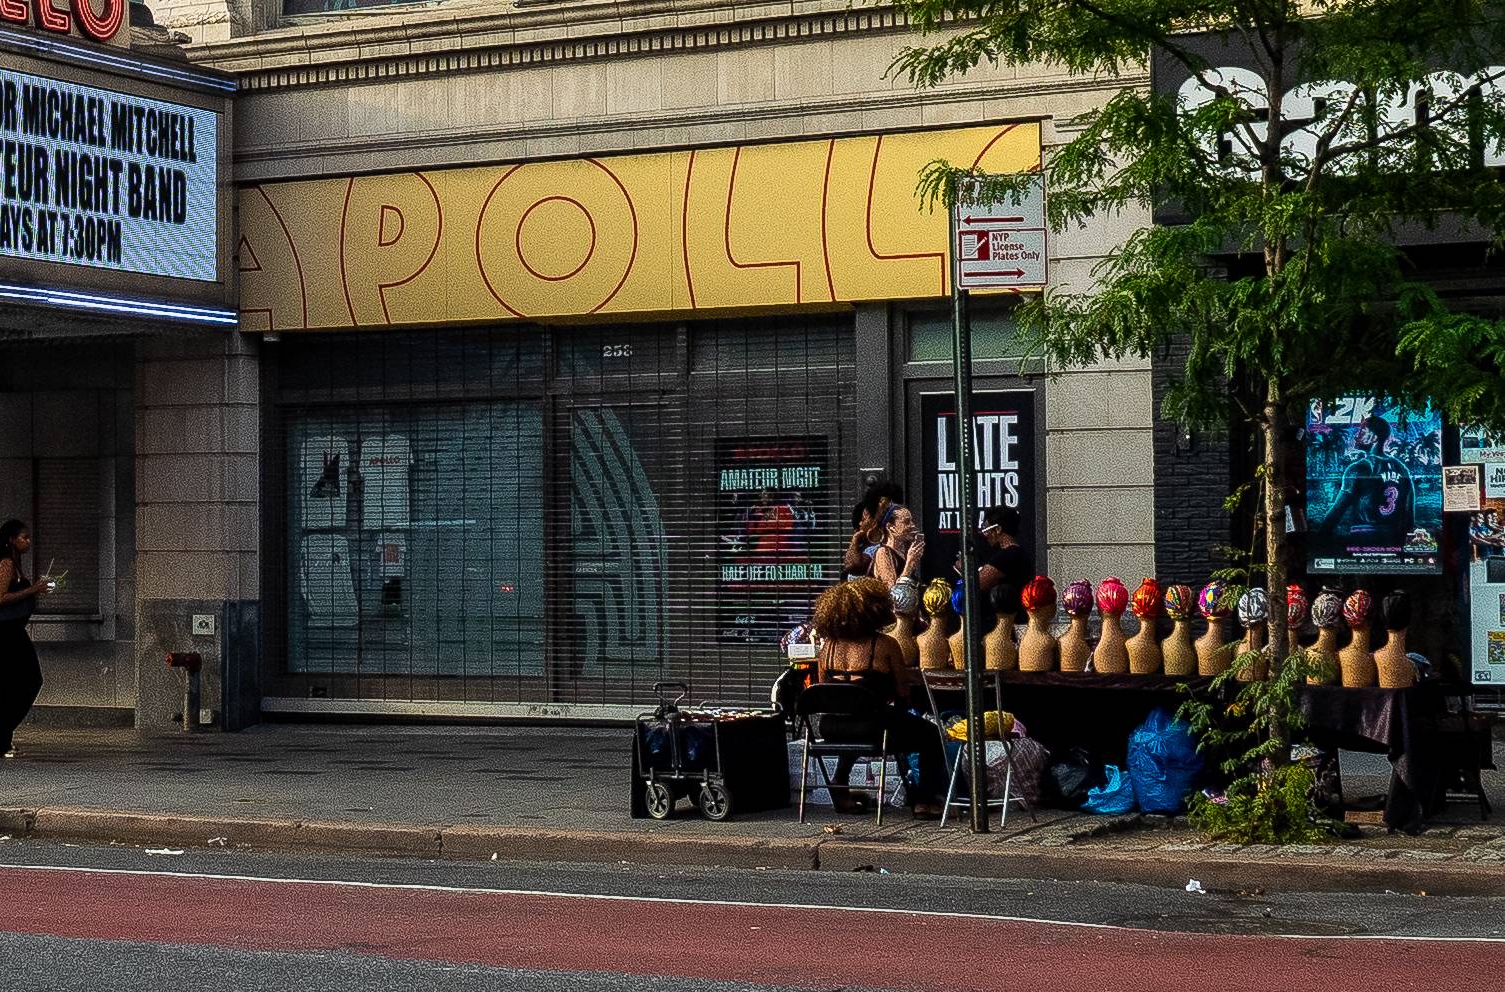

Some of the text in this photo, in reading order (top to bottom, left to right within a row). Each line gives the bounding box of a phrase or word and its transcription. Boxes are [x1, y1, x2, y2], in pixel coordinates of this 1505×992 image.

[21, 83, 106, 147] MICHAEL
[110, 102, 197, 163] MITCHELL
[54, 149, 124, 216] NIGHT
[128, 163, 187, 226] BAND
[36, 211, 59, 254] AT
[61, 215, 122, 264] 7:30PM
[239, 120, 1043, 331] APOLL
[992, 233, 1009, 241] NYP
[992, 242, 1025, 250] License
[992, 251, 1040, 261] Plates Only
[1325, 396, 1375, 424] 2K
[720, 467, 820, 491] AMATEUR NIGHT
[937, 471, 1019, 508] NIHTS
[1379, 486, 1399, 516] 3
